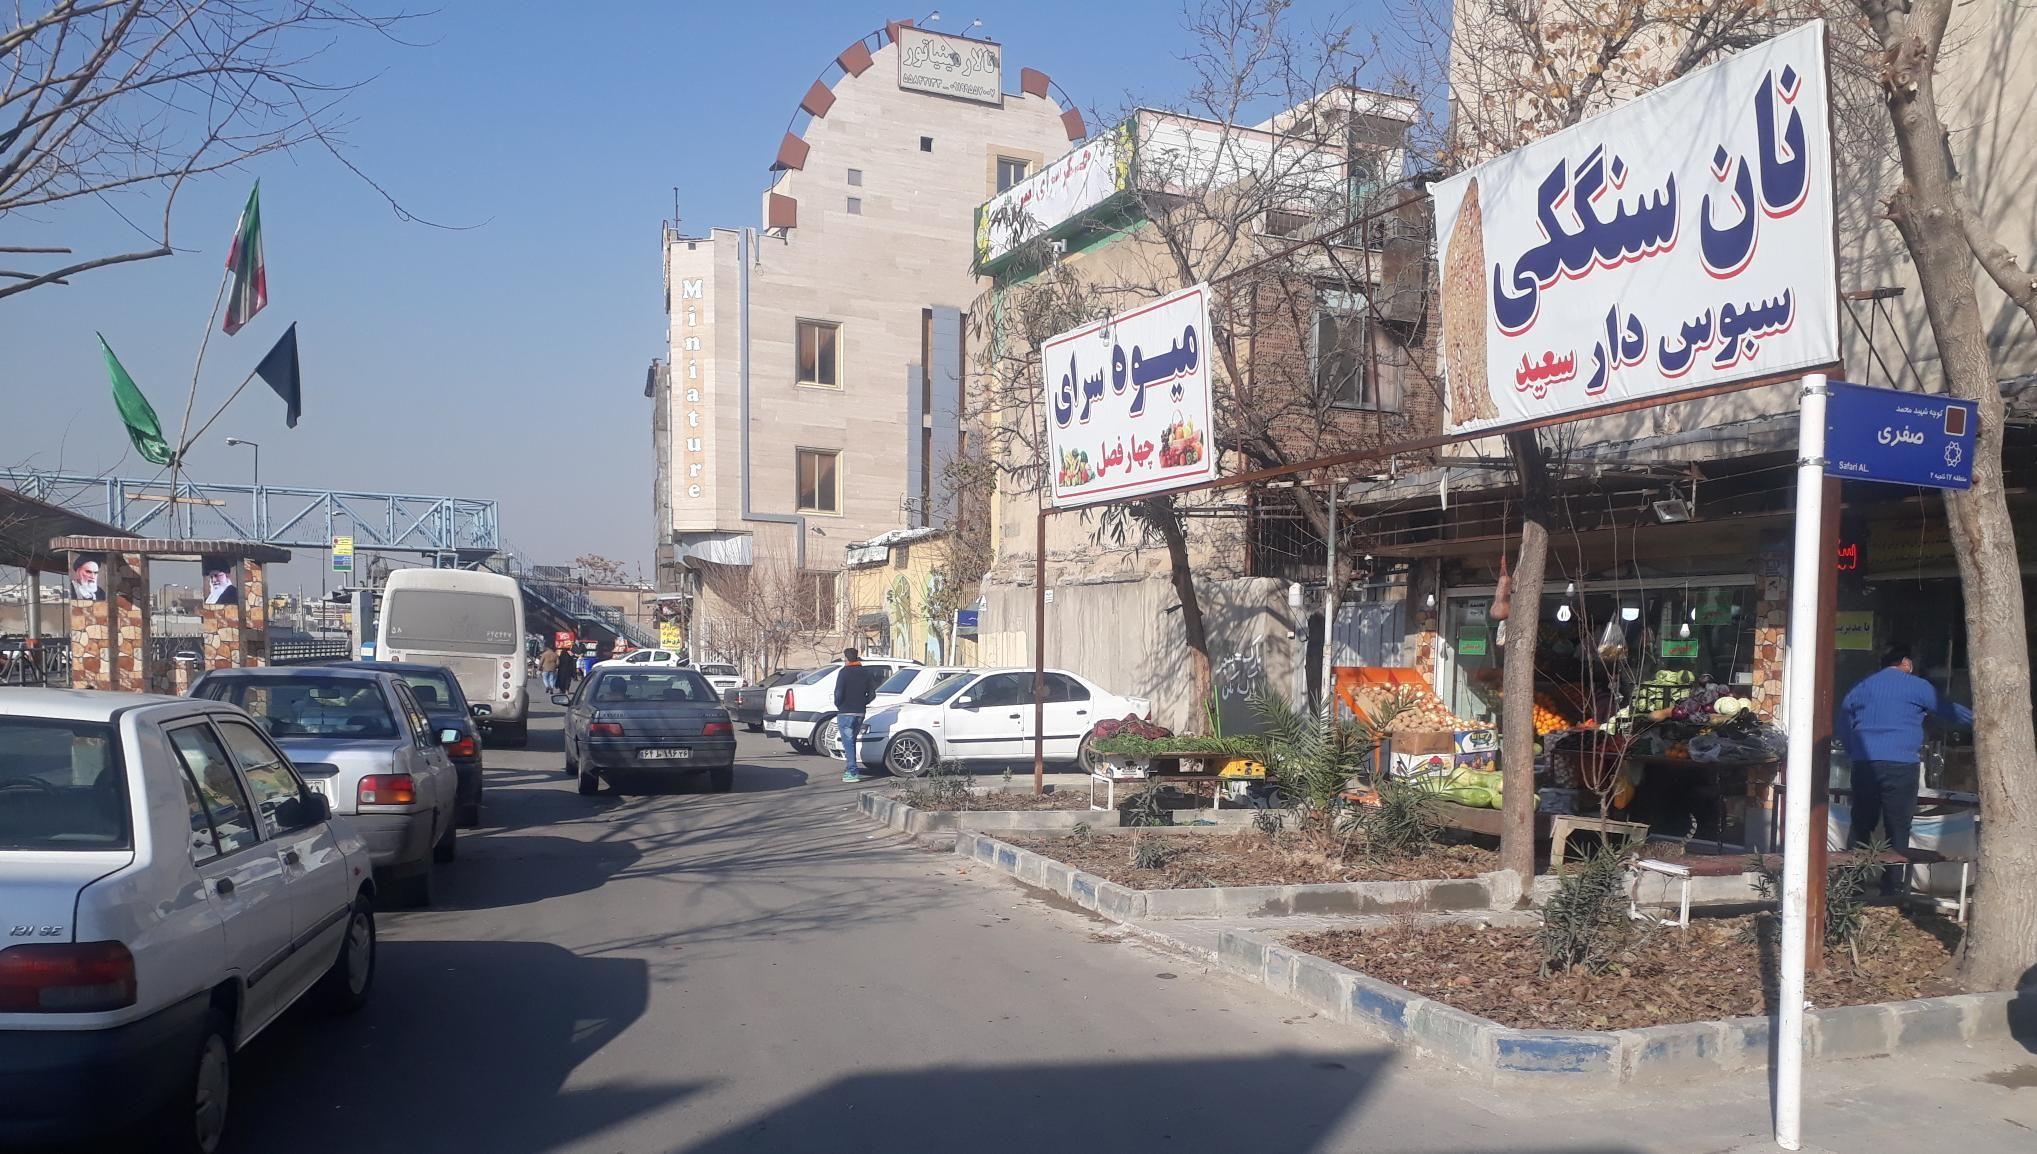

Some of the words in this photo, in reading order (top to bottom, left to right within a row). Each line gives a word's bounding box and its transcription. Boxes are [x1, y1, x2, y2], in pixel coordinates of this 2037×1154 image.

[903, 38, 961, 73] مینیاتور
[961, 47, 995, 77] تالار
[1699, 63, 1811, 280] نان
[1493, 141, 1681, 337] سنگکی
[1585, 302, 1649, 396] دار
[1656, 286, 1796, 379] سبوس
[681, 278, 704, 499] Miniature
[1054, 349, 1106, 429] سرای
[1111, 324, 1200, 418] میوه
[1514, 350, 1579, 400] سعید
[1895, 405, 1913, 414] محمد
[1913, 407, 1929, 417] شهید
[1929, 409, 1943, 419] کوچه
[1124, 433, 1155, 474] چهار
[1877, 424, 1924, 447] صفری
[1096, 435, 1124, 478] فصل
[1838, 460, 1857, 472] Safari
[1857, 463, 1869, 472] AL.
[1934, 473, 1946, 481] ناحیه
[1863, 622, 1870, 631] با
[9, 925, 35, 937] 131
[38, 925, 64, 937] SE
